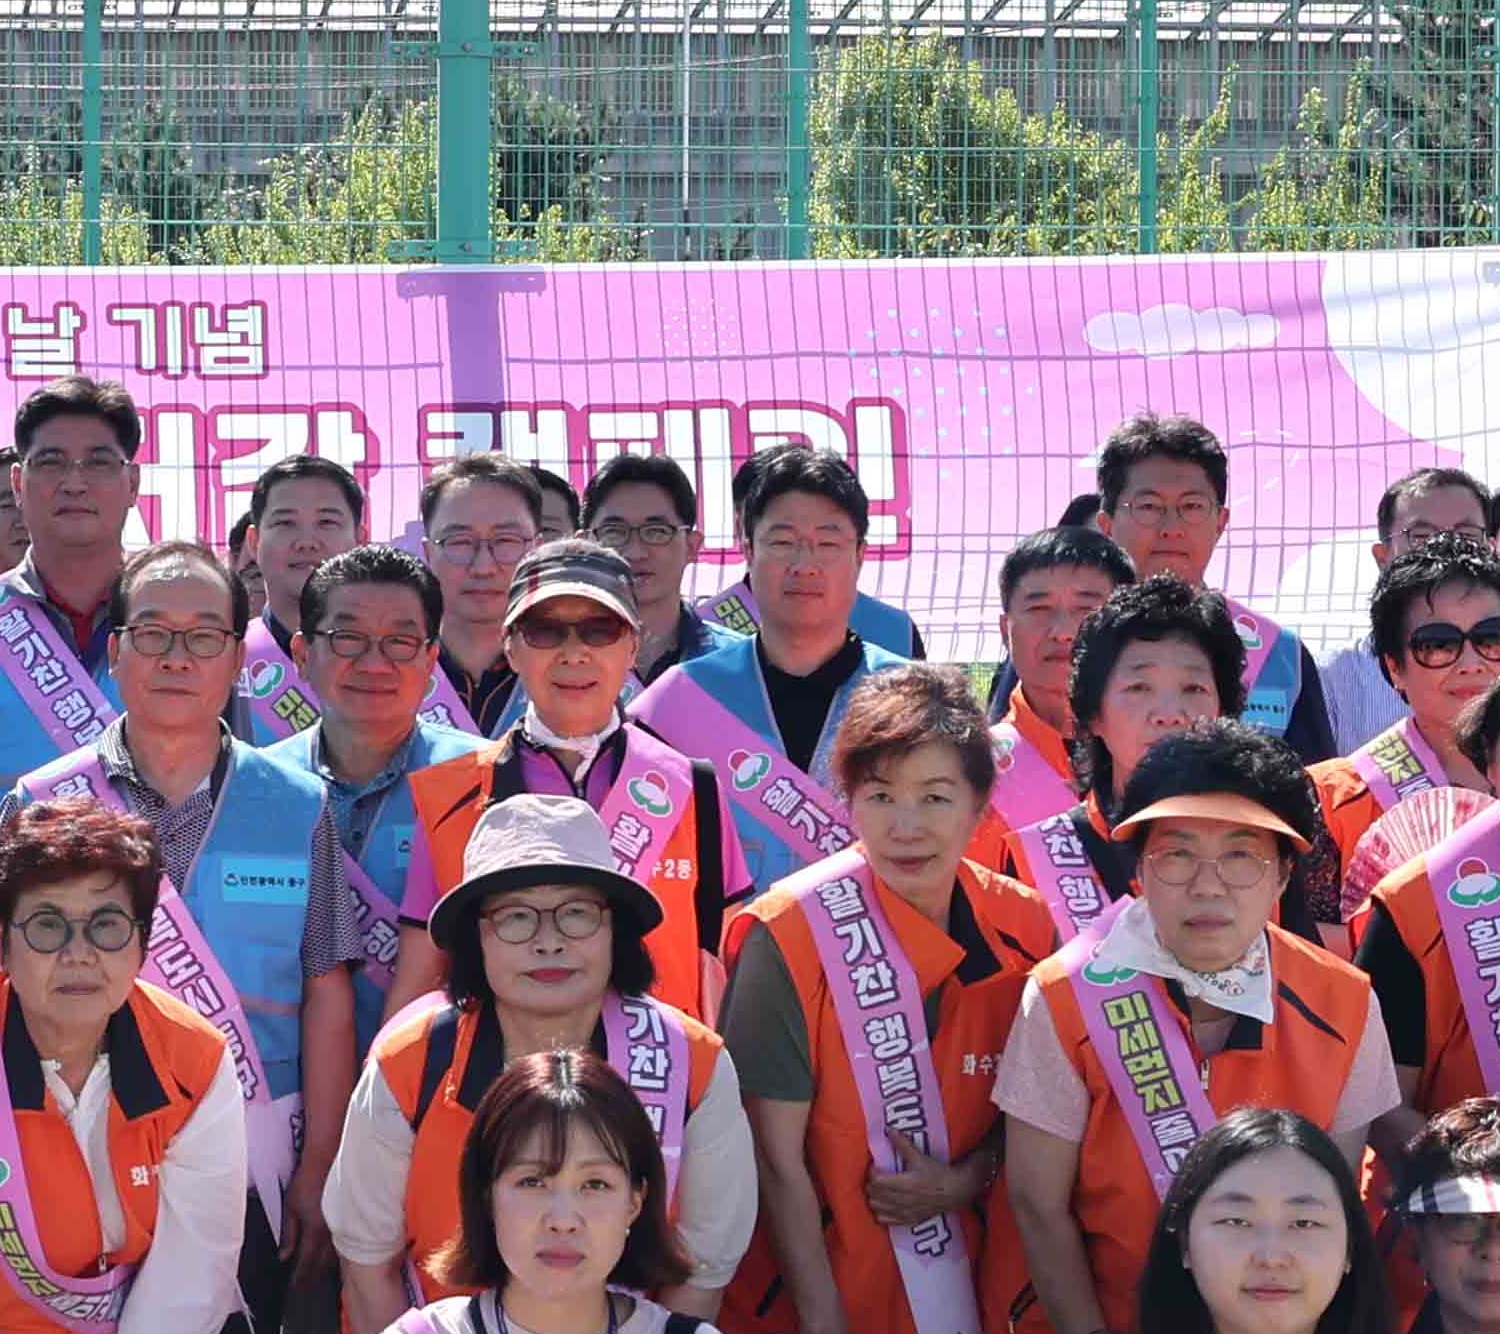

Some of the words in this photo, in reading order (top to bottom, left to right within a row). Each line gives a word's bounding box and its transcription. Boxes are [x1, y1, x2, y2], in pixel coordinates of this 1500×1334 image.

[6, 301, 86, 380] 날
[108, 300, 270, 380] 기념
[814, 875, 899, 1009] 활기찬
[1102, 990, 1188, 1116] 미세먼지
